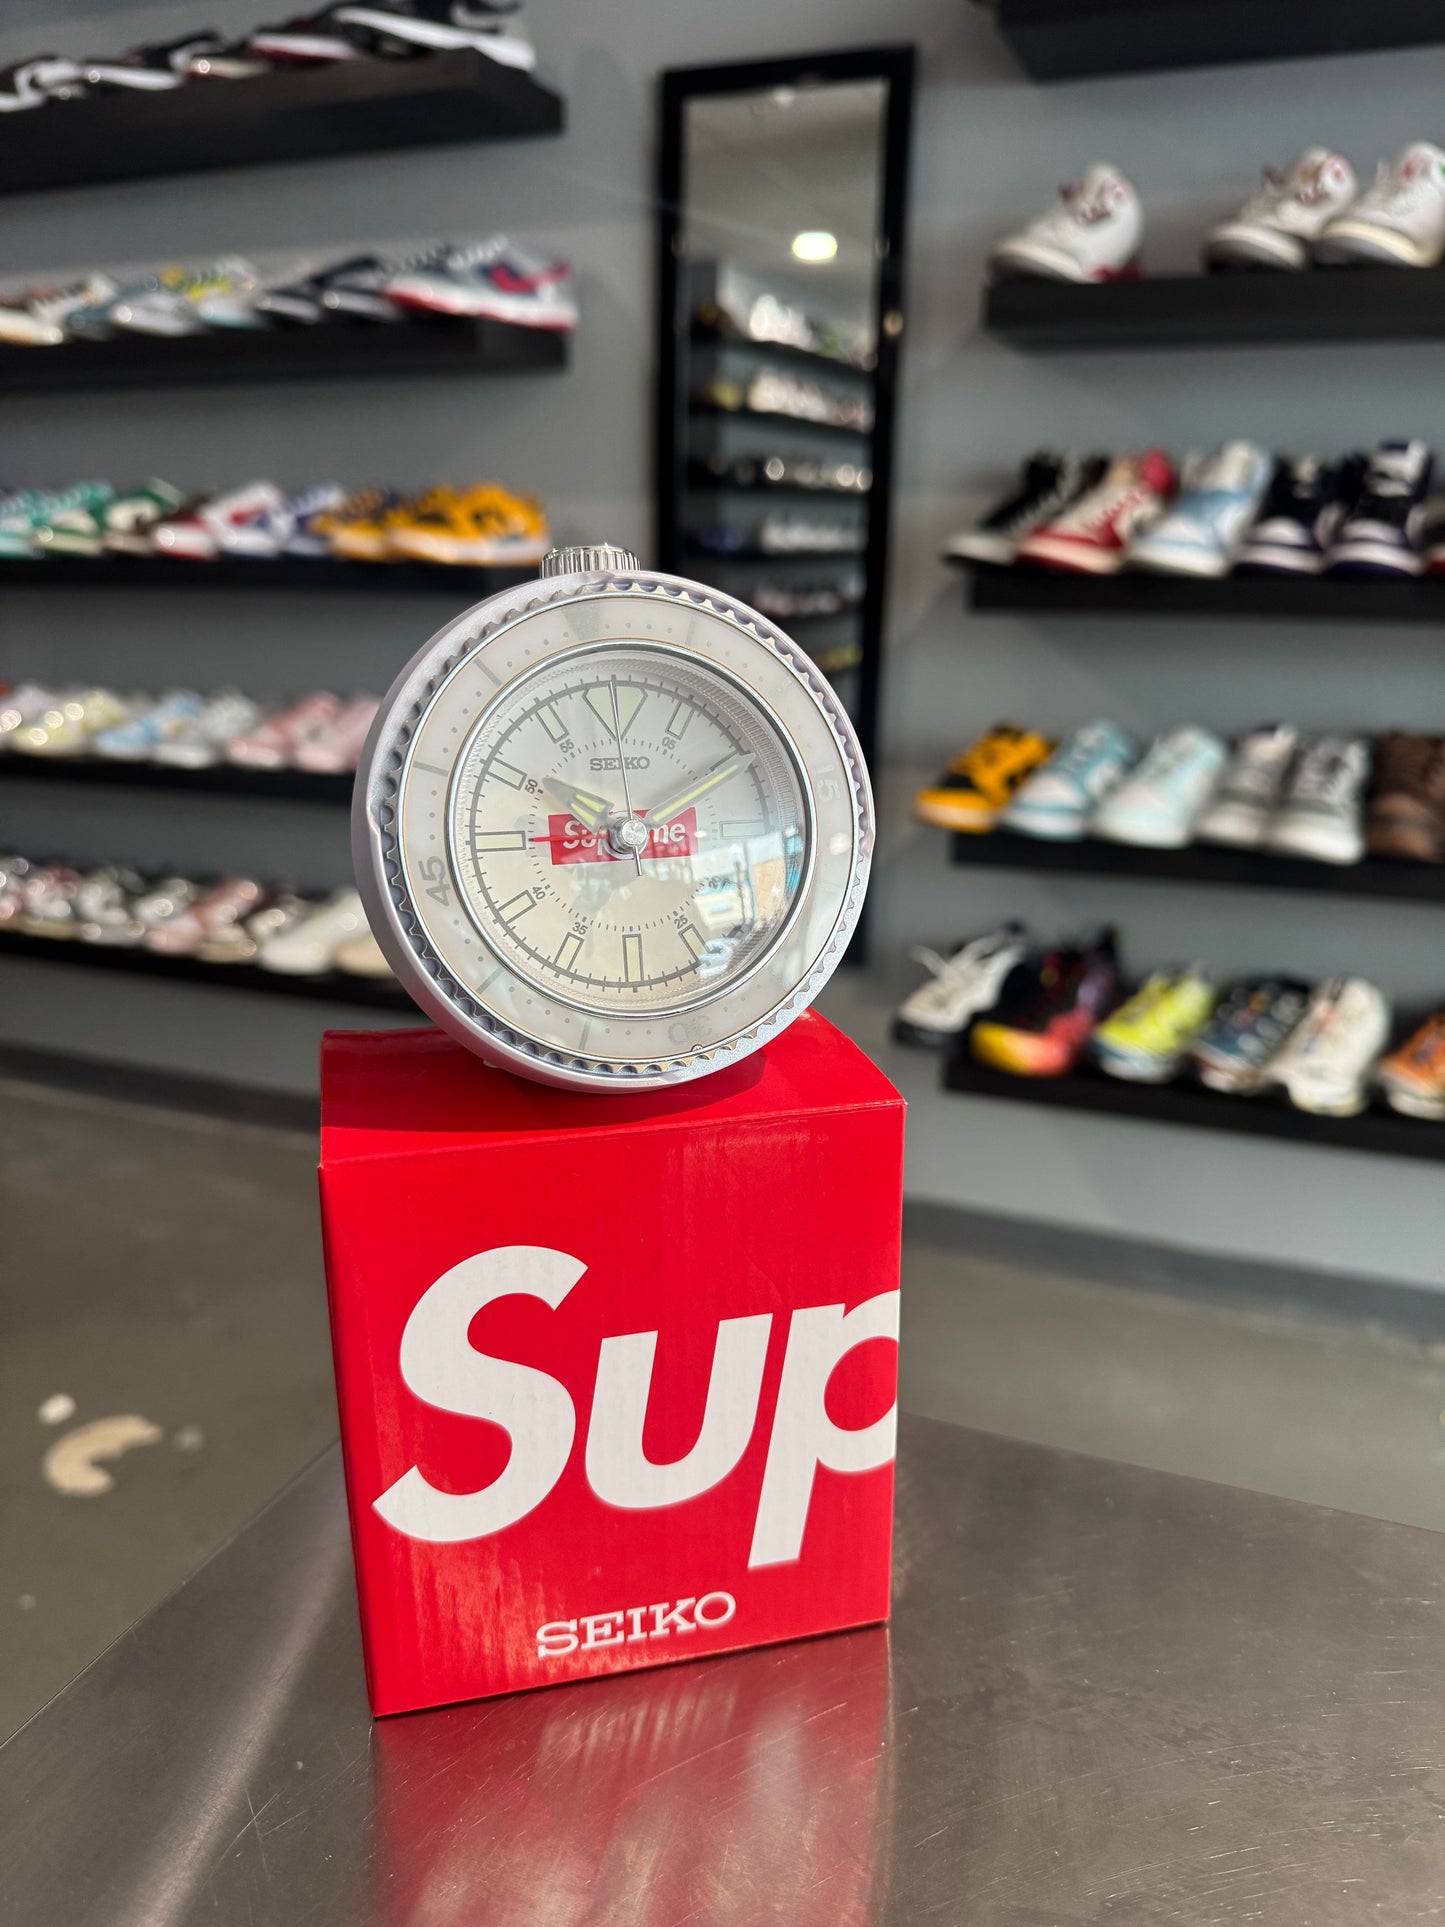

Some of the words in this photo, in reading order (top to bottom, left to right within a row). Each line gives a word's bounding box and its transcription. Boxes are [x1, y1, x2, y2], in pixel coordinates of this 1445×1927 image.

[559, 738, 575, 754] 55
[662, 736, 677, 751] 05
[589, 756, 651, 772] SEIKO
[525, 778, 538, 794] 50
[418, 855, 451, 907] 45
[532, 886, 546, 900] 40
[571, 922, 588, 936] 35
[673, 914, 688, 929] 25
[371, 1244, 900, 1571] Sup
[535, 1591, 737, 1658] SEIKO
